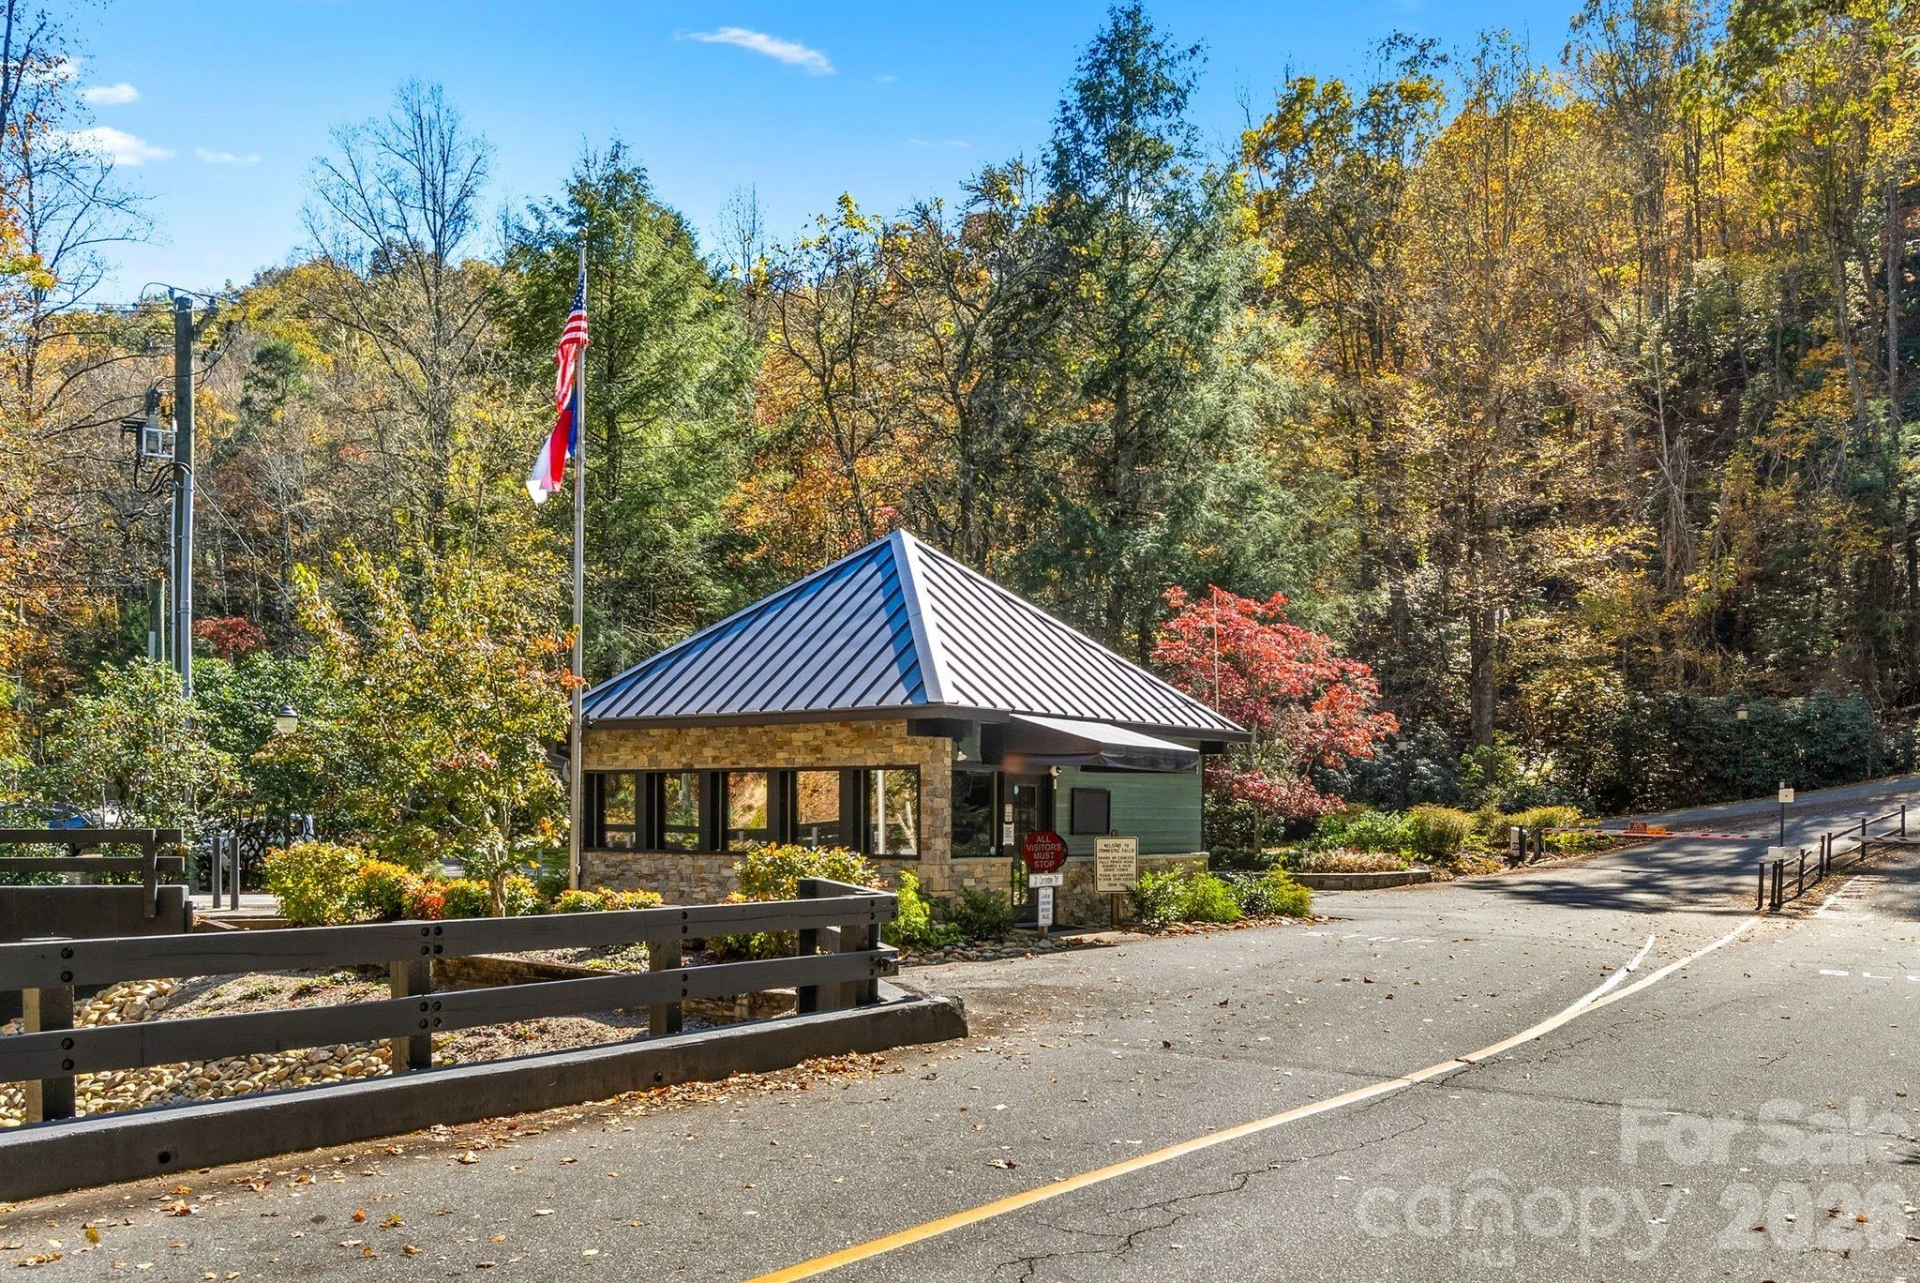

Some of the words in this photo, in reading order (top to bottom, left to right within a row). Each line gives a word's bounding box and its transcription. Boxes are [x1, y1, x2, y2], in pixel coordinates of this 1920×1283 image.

[1036, 835, 1052, 843] ALL
[1026, 843, 1062, 852] VISITORS
[1033, 851, 1055, 860] MUST
[1034, 860, 1055, 868] STOP
